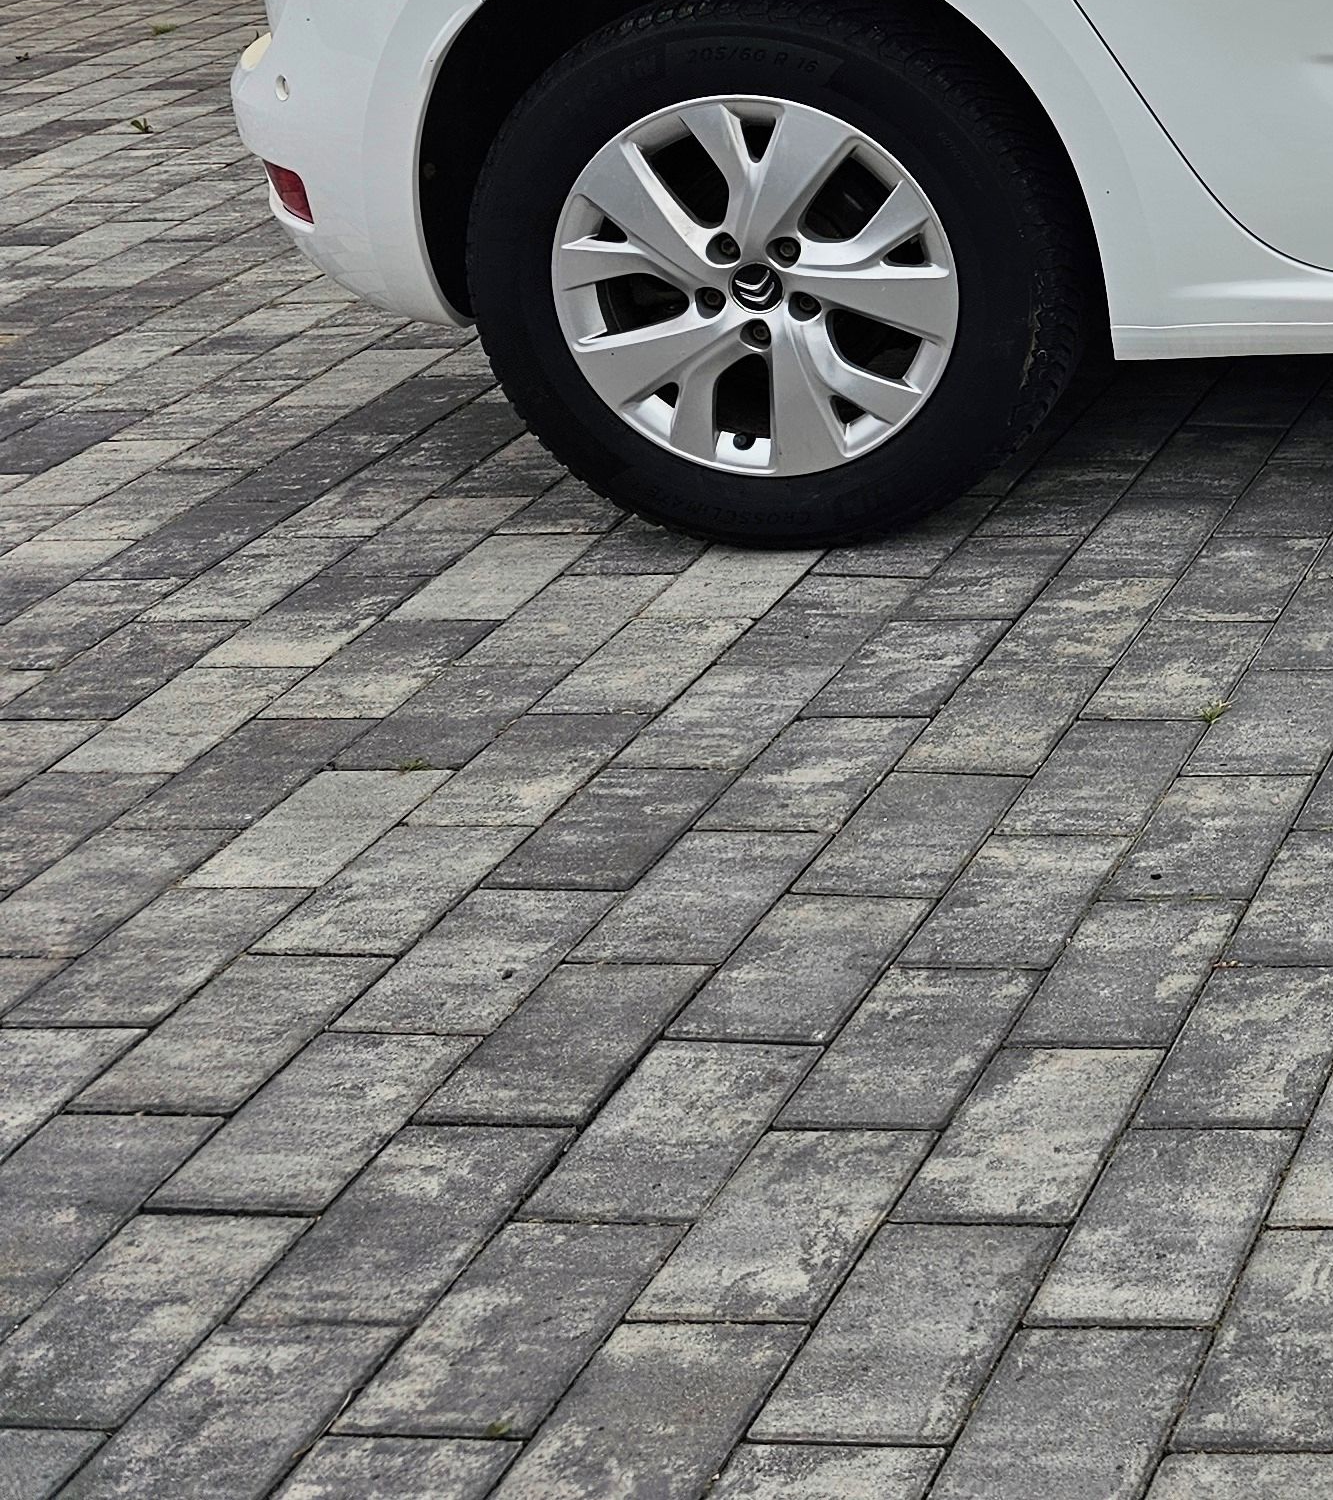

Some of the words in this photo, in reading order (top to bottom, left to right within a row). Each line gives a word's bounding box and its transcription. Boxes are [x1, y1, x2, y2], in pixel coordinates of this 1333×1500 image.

[686, 45, 767, 65] 205/60
[773, 51, 789, 67] R
[796, 57, 820, 74] 16
